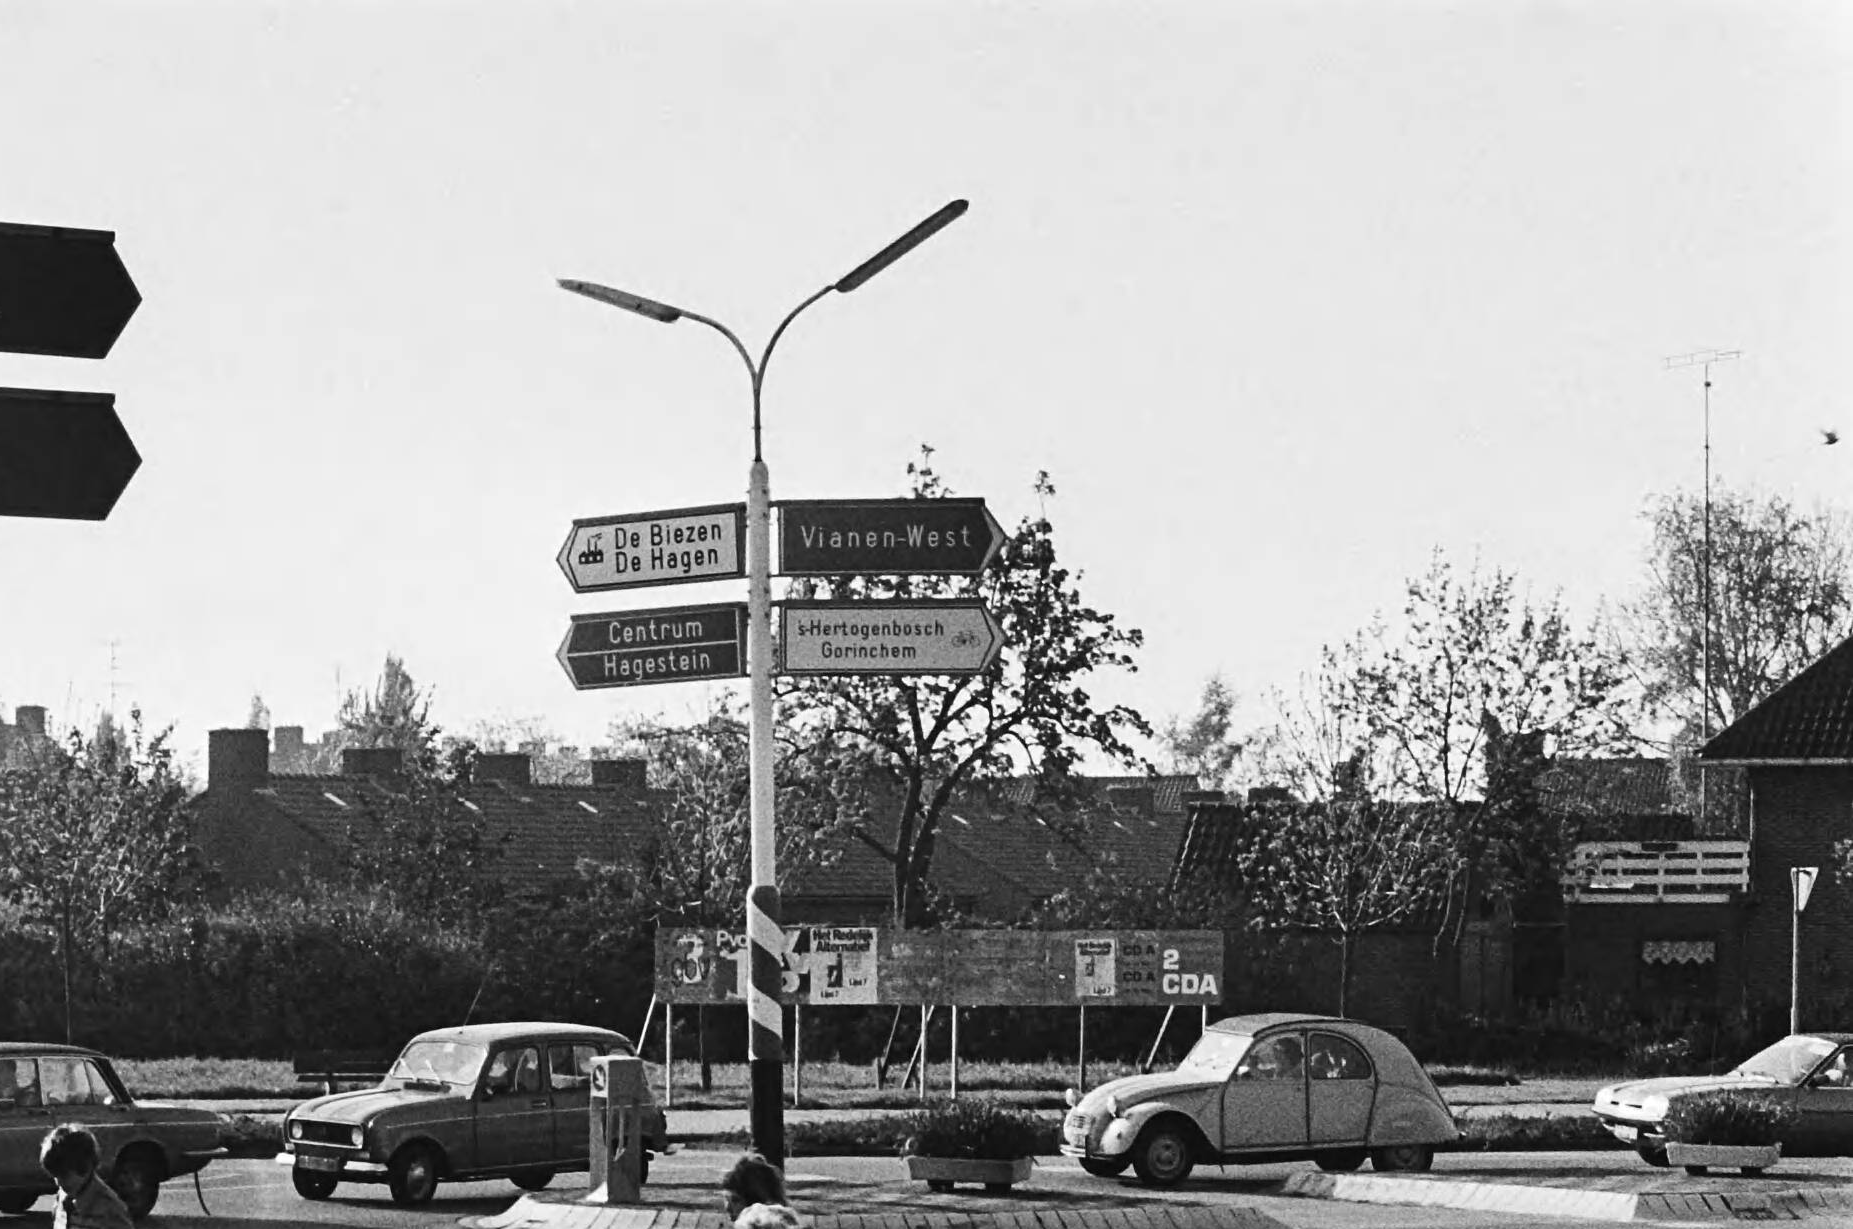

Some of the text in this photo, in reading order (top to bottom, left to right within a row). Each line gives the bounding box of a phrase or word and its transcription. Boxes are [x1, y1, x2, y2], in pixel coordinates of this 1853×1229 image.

[615, 523, 722, 550] De Biezen
[800, 524, 971, 549] Vianen-West
[615, 547, 719, 574] De Hagen
[609, 619, 703, 644] Centrum
[821, 641, 917, 659] Gorinchem
[604, 649, 711, 680] Hagestein
[1162, 948, 1179, 970] 2
[1162, 973, 1218, 995] CDA
